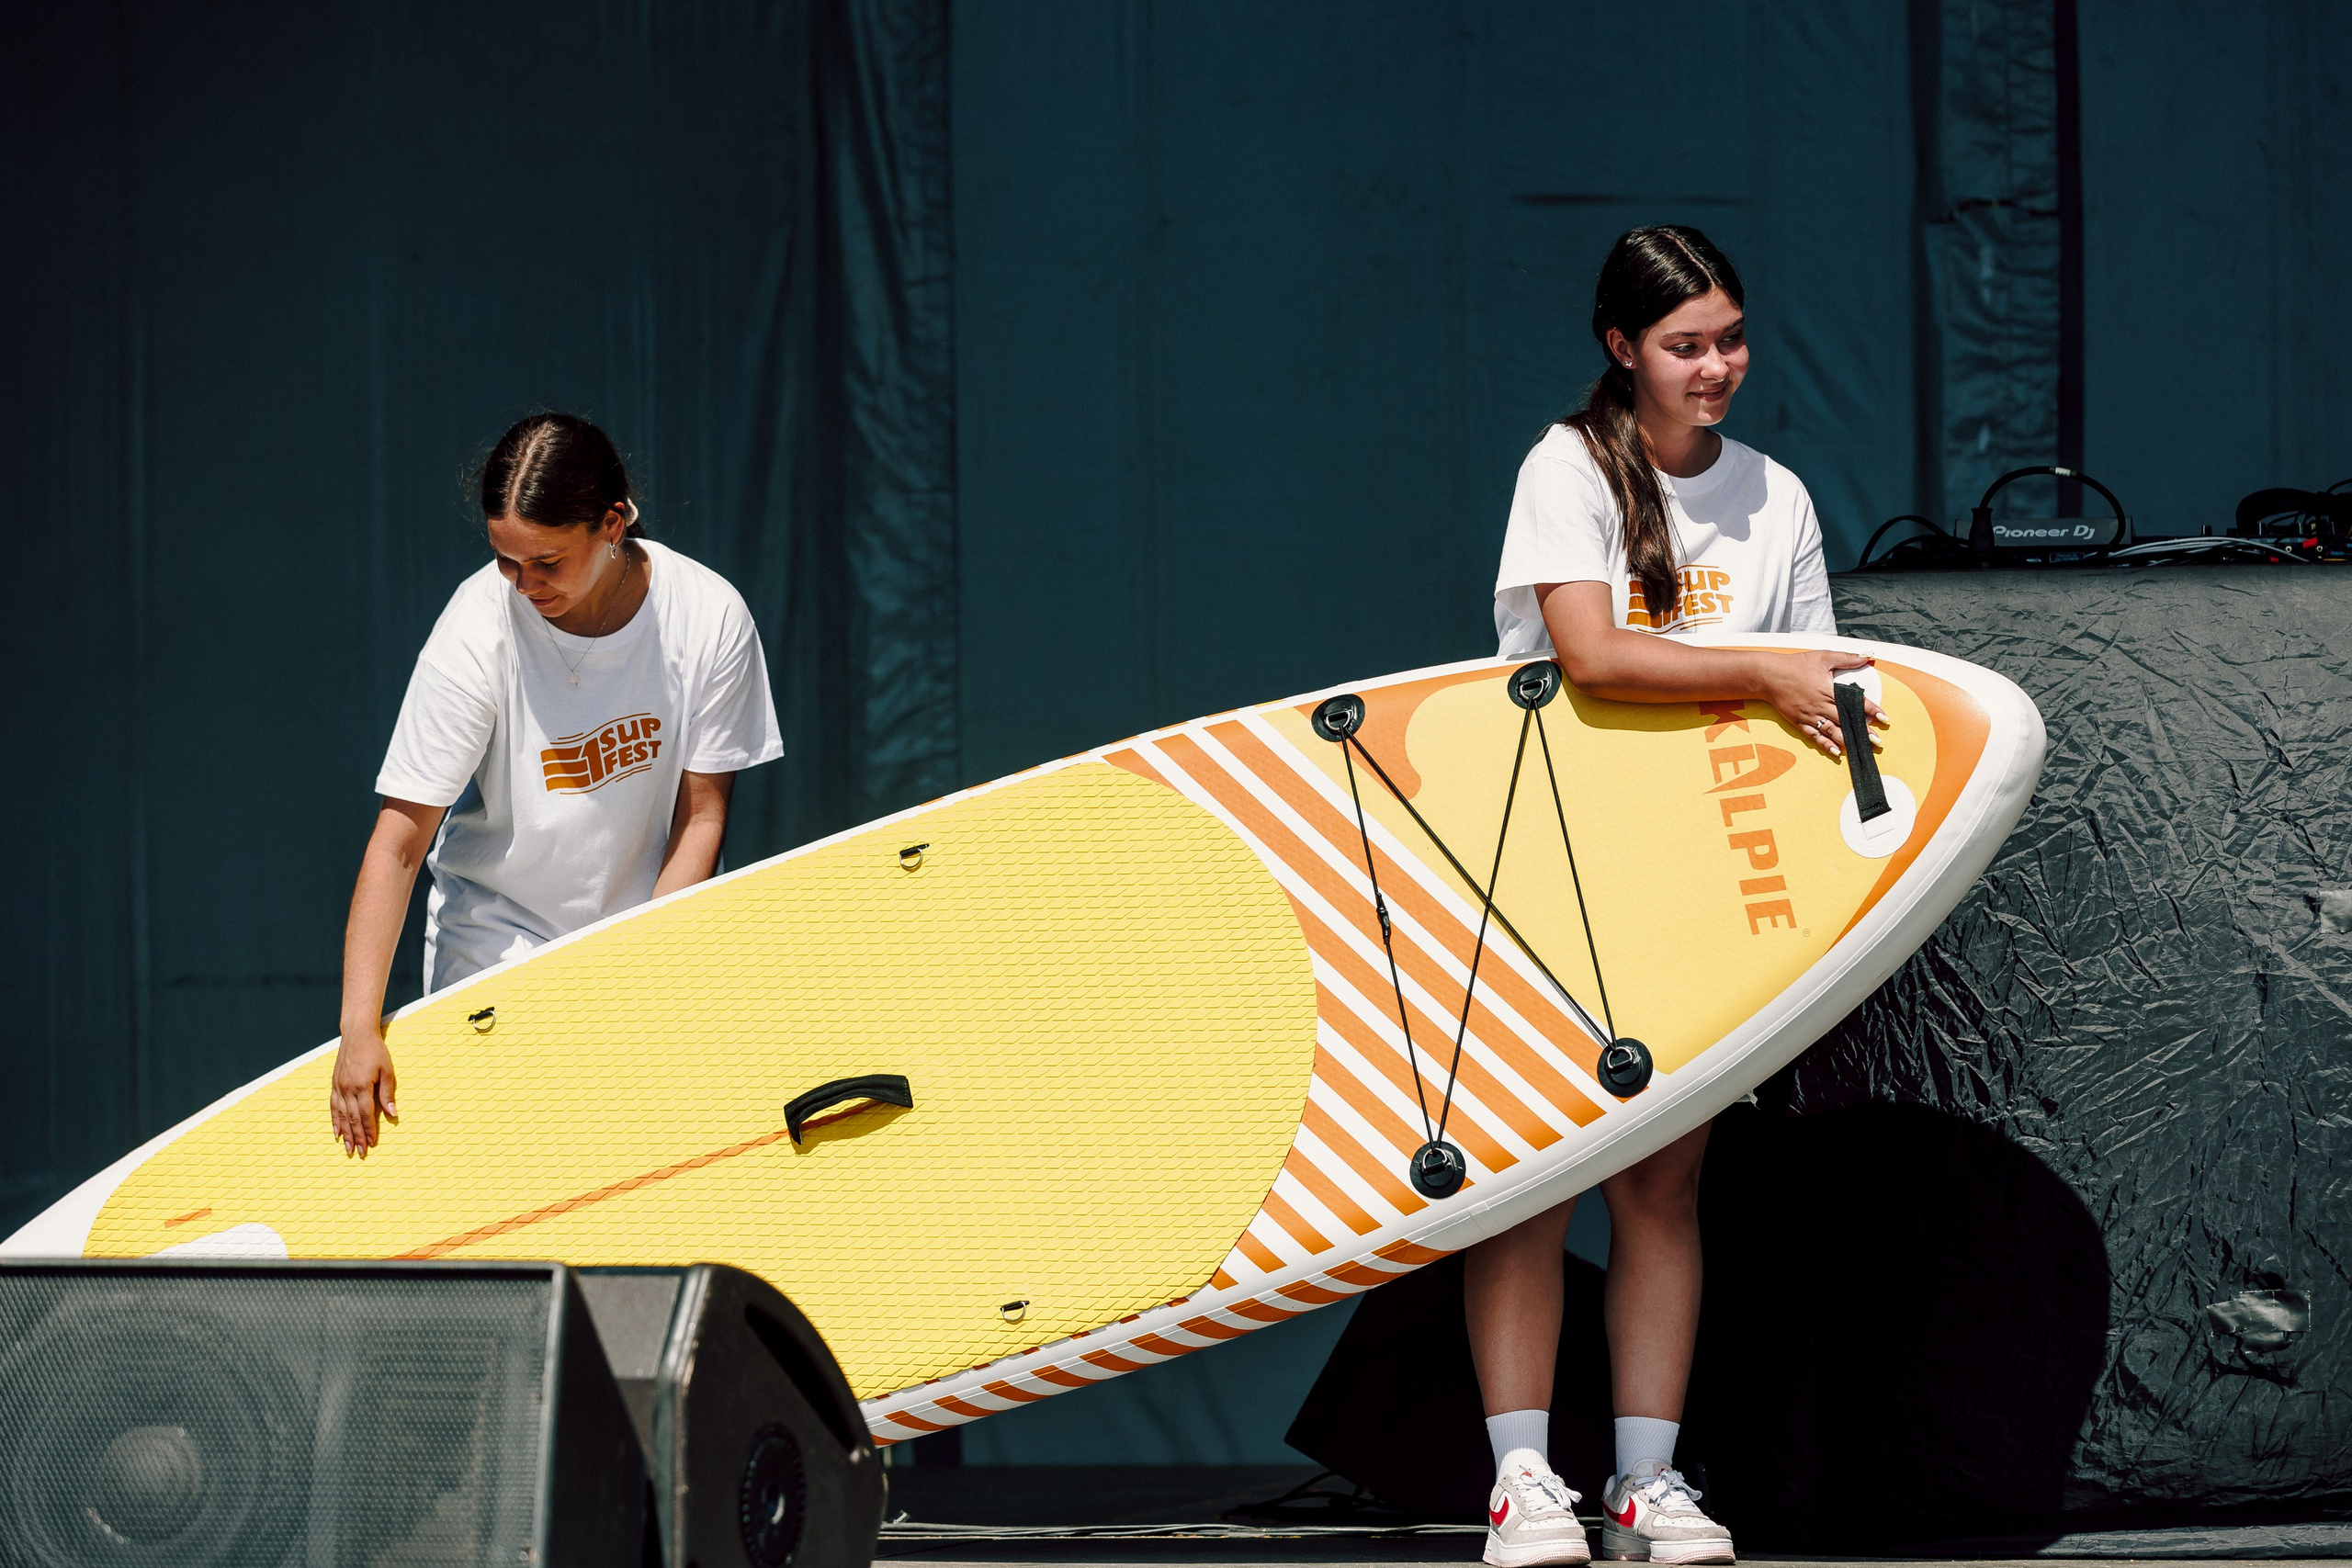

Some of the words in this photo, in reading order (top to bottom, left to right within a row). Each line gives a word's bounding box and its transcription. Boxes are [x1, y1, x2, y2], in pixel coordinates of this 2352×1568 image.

[1992, 525, 2070, 538] Pioneer
[599, 717, 662, 754] SUP
[603, 739, 662, 775] FEST
